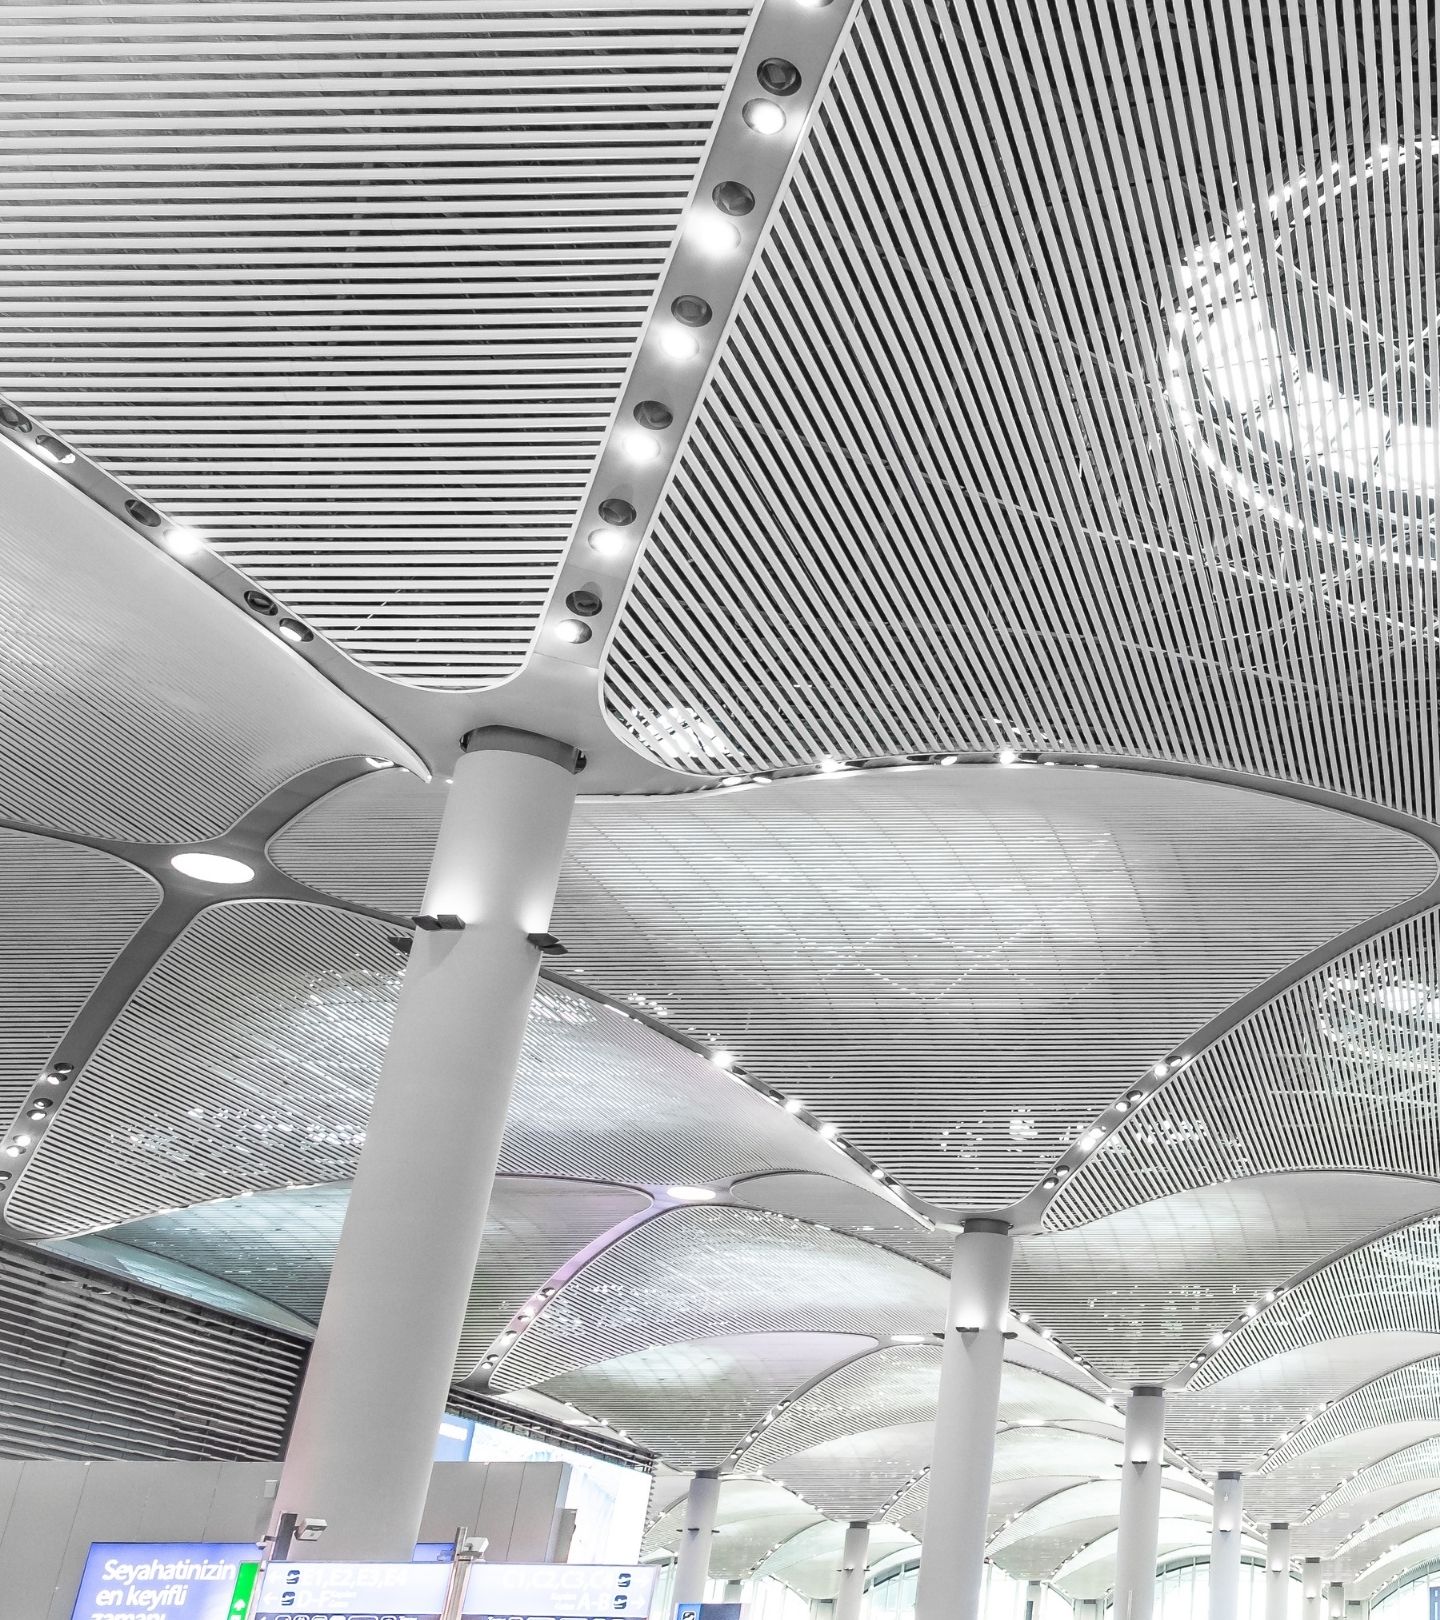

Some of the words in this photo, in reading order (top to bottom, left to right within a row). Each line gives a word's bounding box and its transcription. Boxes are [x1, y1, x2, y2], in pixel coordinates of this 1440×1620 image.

[103, 1559, 237, 1586] Seyahatinizin
[96, 1588, 125, 1606] en
[127, 1585, 188, 1611] keyifli
